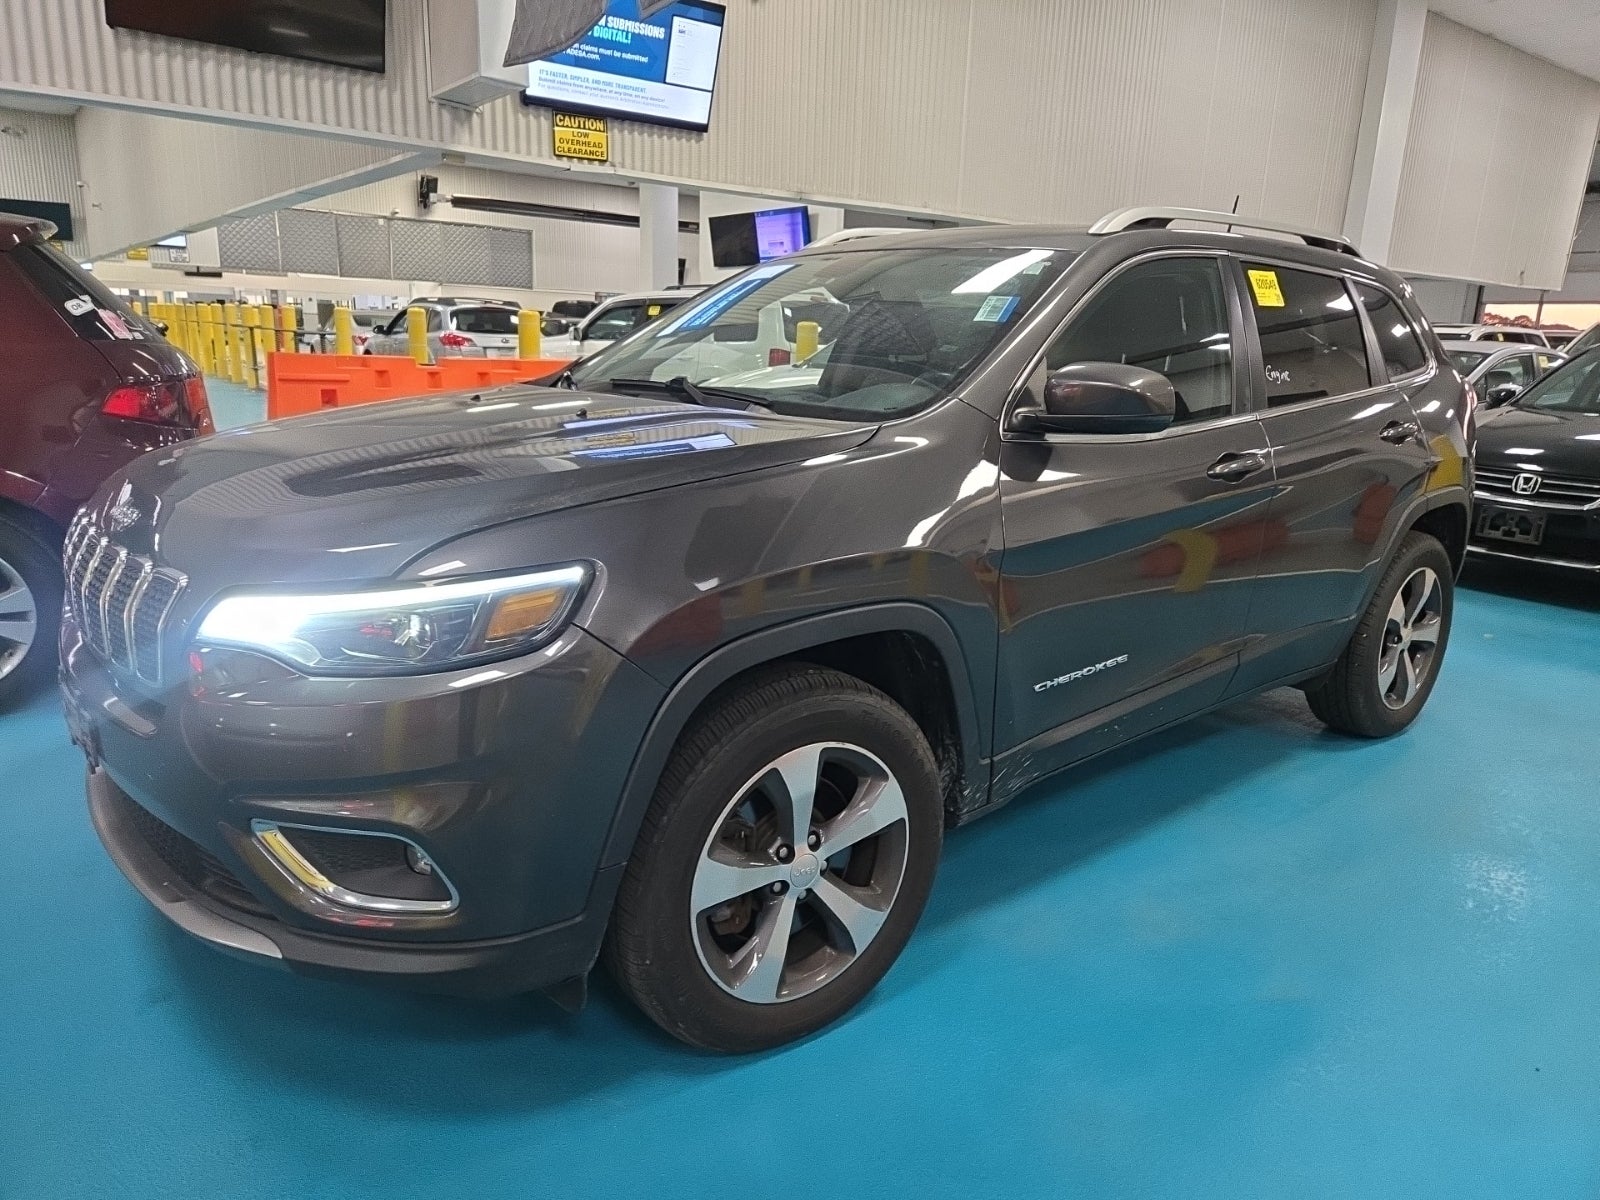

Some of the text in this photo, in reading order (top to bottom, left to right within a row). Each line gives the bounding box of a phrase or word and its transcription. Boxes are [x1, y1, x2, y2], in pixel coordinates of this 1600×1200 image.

[593, 25, 632, 44] DIGITAL!
[607, 16, 665, 39] SUBMISSIONS
[580, 43, 598, 53] claims
[622, 52, 649, 63] submitted
[556, 114, 604, 131] CAUTION
[559, 137, 603, 149] OVERHEAD
[572, 130, 590, 139] LOW
[557, 145, 605, 158] CLEARANCE
[1265, 365, 1290, 384] Engine
[1033, 654, 1128, 692] CHEROKEE
